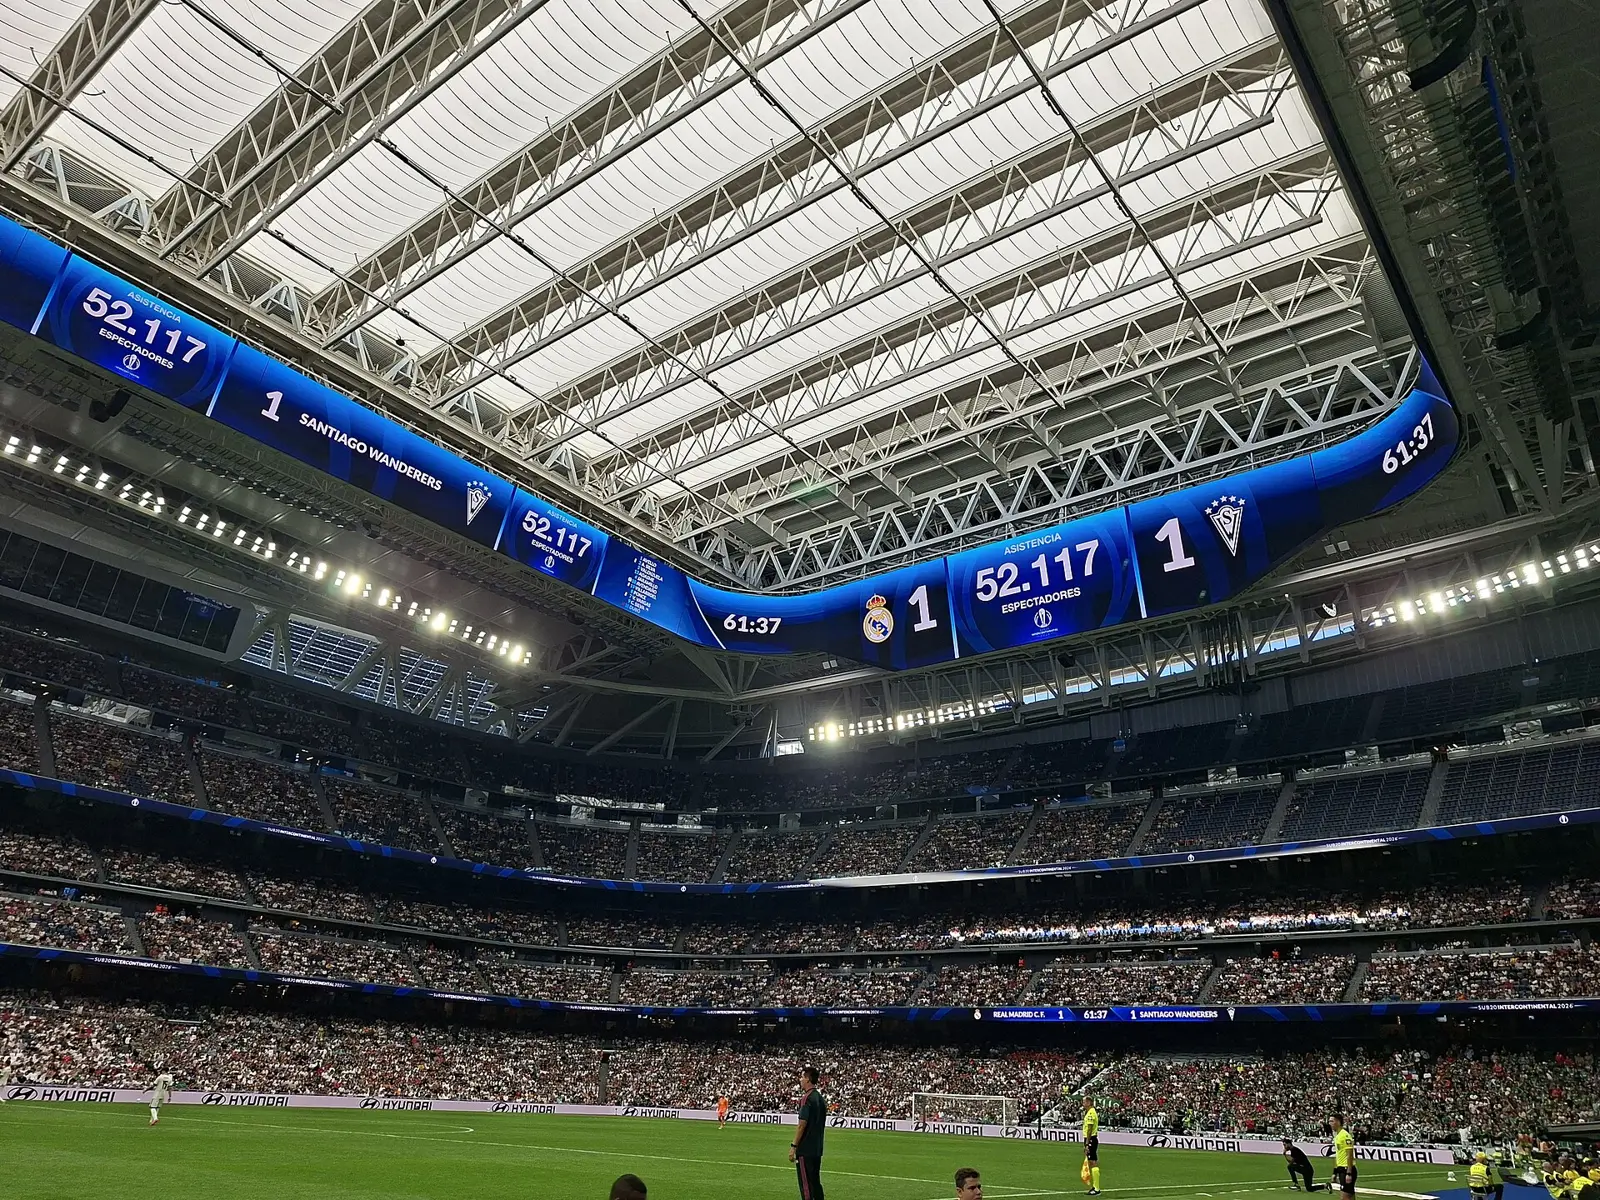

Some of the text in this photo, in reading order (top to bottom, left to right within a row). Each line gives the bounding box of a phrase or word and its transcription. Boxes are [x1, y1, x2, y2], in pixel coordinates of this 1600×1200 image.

[128, 291, 181, 323] ASISTENCIA
[82, 287, 206, 363] 52.117
[99, 328, 174, 369] ESPECTADORES
[261, 390, 443, 491] 1 SANTIAGO WANDERERS
[1382, 413, 1435, 474] 61:37
[547, 509, 578, 529] ASISTENCIA
[522, 510, 592, 558] 52.117
[531, 539, 574, 564] ESPECTADORES
[1004, 532, 1062, 556] ASISTENCIA
[1154, 518, 1195, 572] 1
[976, 539, 1100, 602] 52.117
[908, 585, 938, 632] 1
[1002, 587, 1081, 614] ESPECTADORES
[723, 614, 782, 634] 61:37
[1058, 1010, 1064, 1019] 1
[1084, 1010, 1108, 1019] 61:37
[1130, 1010, 1136, 1020] 1
[42, 1089, 116, 1102] HYUNDAI
[229, 1095, 288, 1106] HYUNDAI
[382, 1100, 432, 1110] HYUNDAI
[512, 1104, 556, 1114] HYUNDAI
[640, 1108, 680, 1119] HYUNDAI
[740, 1113, 782, 1124] HYUNDAI
[850, 1118, 896, 1131] HYUNDAI
[932, 1122, 982, 1136] HYUNDAI
[1024, 1128, 1079, 1142] HYUNDAI
[1174, 1137, 1240, 1152] HYUNDAI
[1354, 1148, 1434, 1164] HYUNDAI
